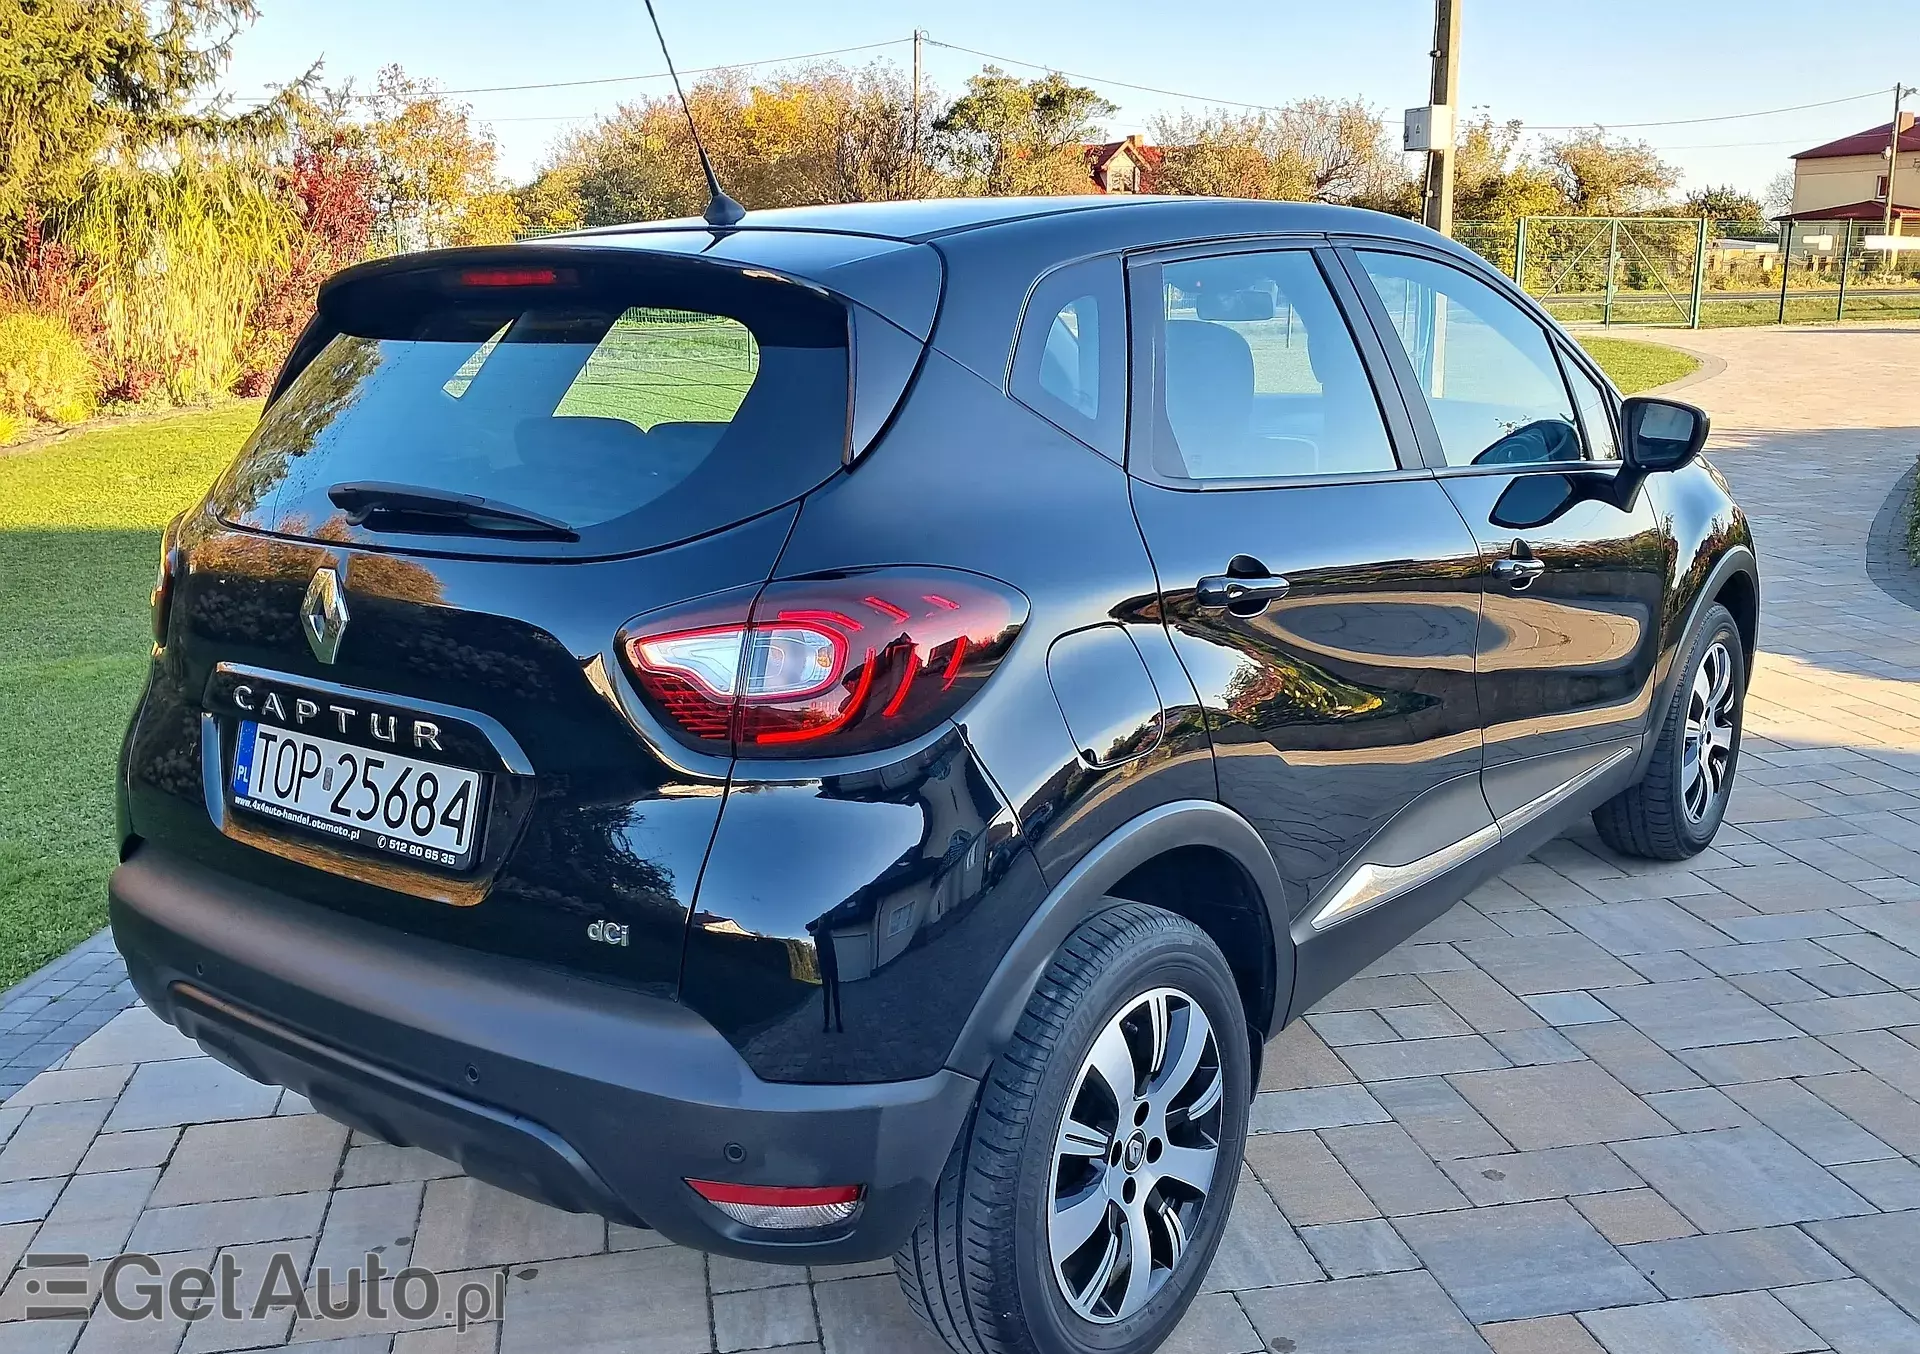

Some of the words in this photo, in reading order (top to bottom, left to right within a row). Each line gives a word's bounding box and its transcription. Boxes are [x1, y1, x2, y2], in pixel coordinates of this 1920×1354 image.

[232, 685, 443, 751] CAPTUR
[236, 765, 249, 783] PL
[257, 731, 322, 804] TOP
[329, 753, 471, 847] 25684
[234, 796, 360, 841] www.4x4auto-handel.otomoto.pl
[388, 839, 408, 853] 512
[440, 853, 456, 865] 35
[587, 919, 629, 947] dCi
